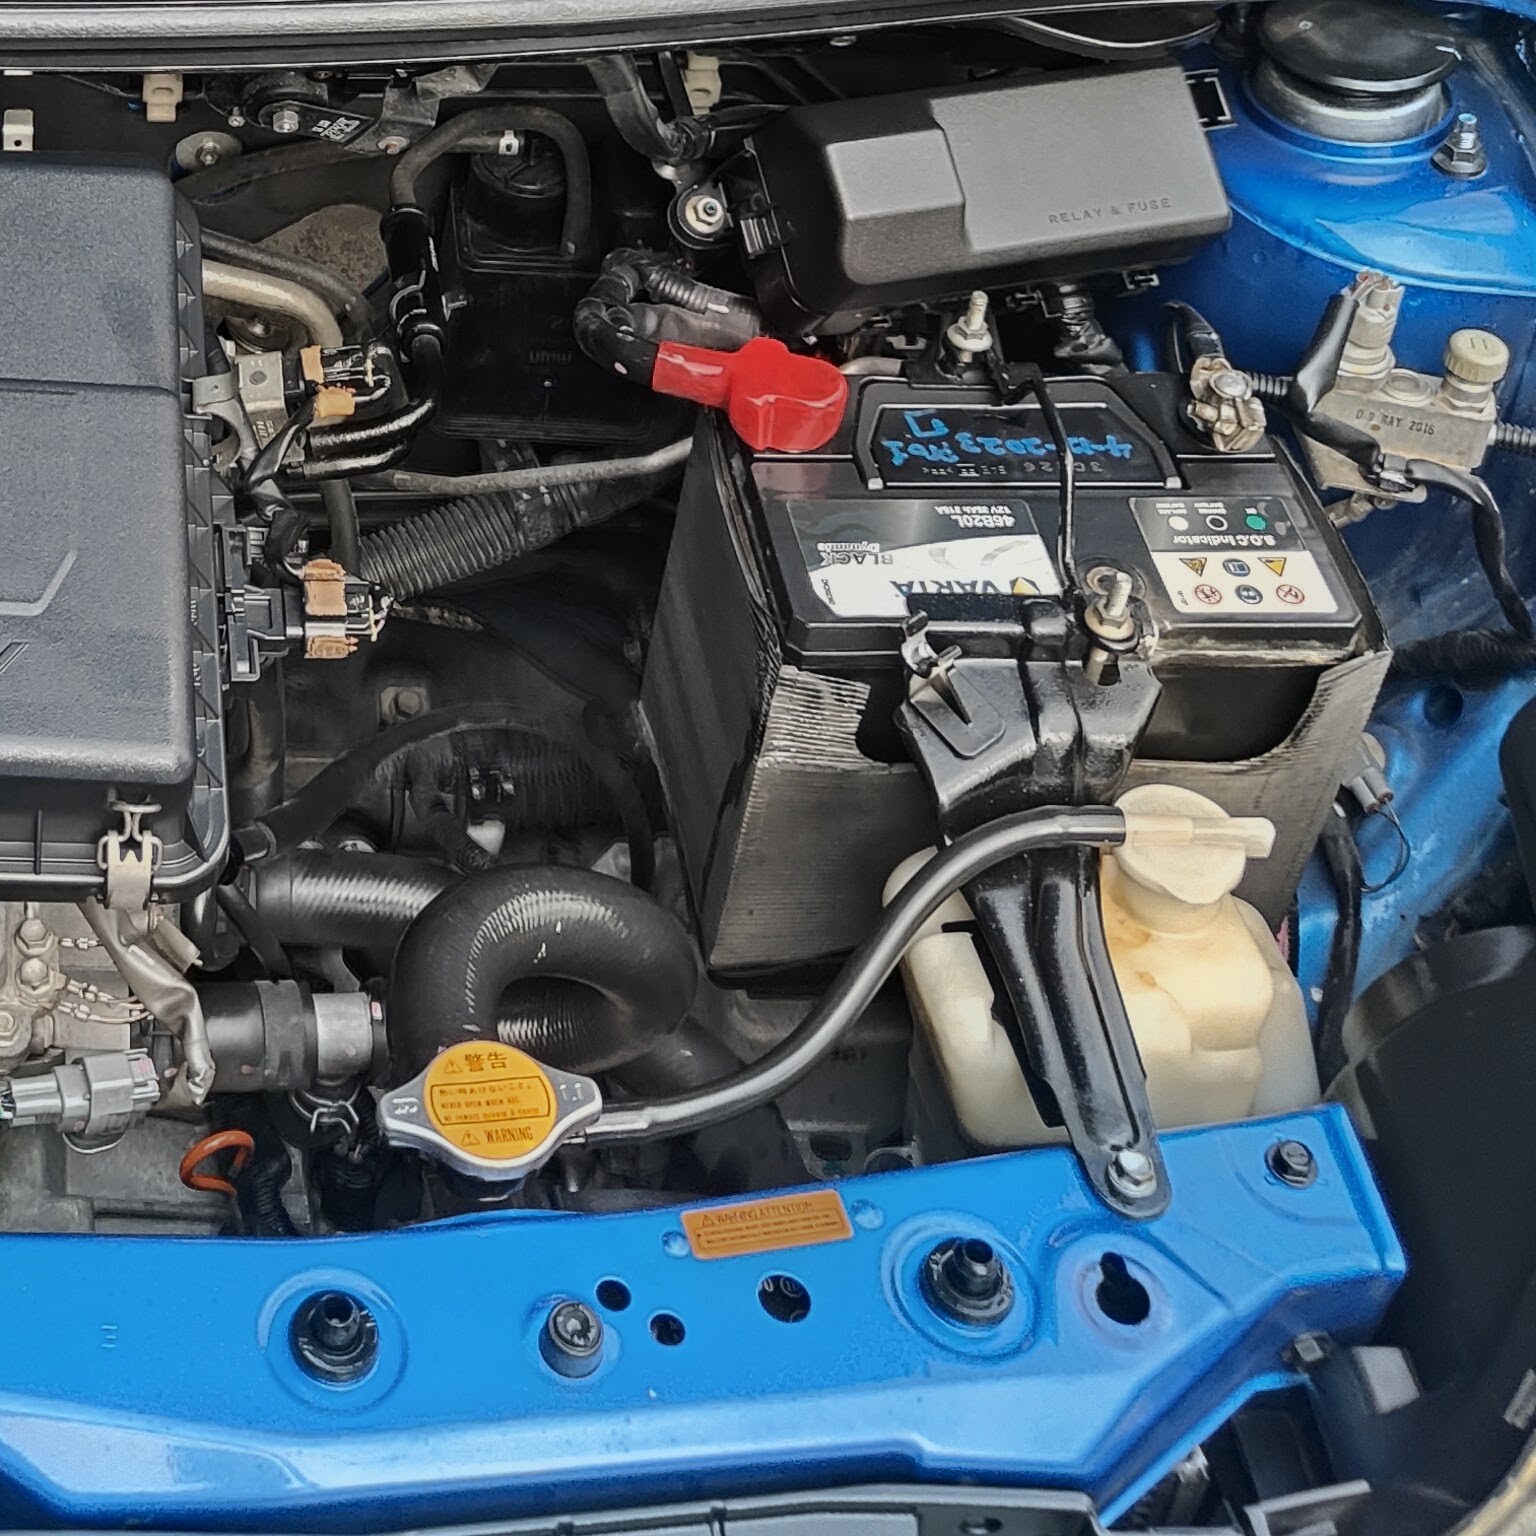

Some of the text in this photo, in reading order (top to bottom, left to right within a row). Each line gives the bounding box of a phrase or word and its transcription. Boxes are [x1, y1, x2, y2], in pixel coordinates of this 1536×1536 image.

[1048, 197, 1172, 224] RELAY & FUSE
[949, 514, 1016, 529] 46B20L
[1172, 534, 1236, 547] Indicator
[818, 551, 894, 567] BLACK
[464, 1051, 507, 1073] 警告
[484, 1126, 534, 1144] WARNING
